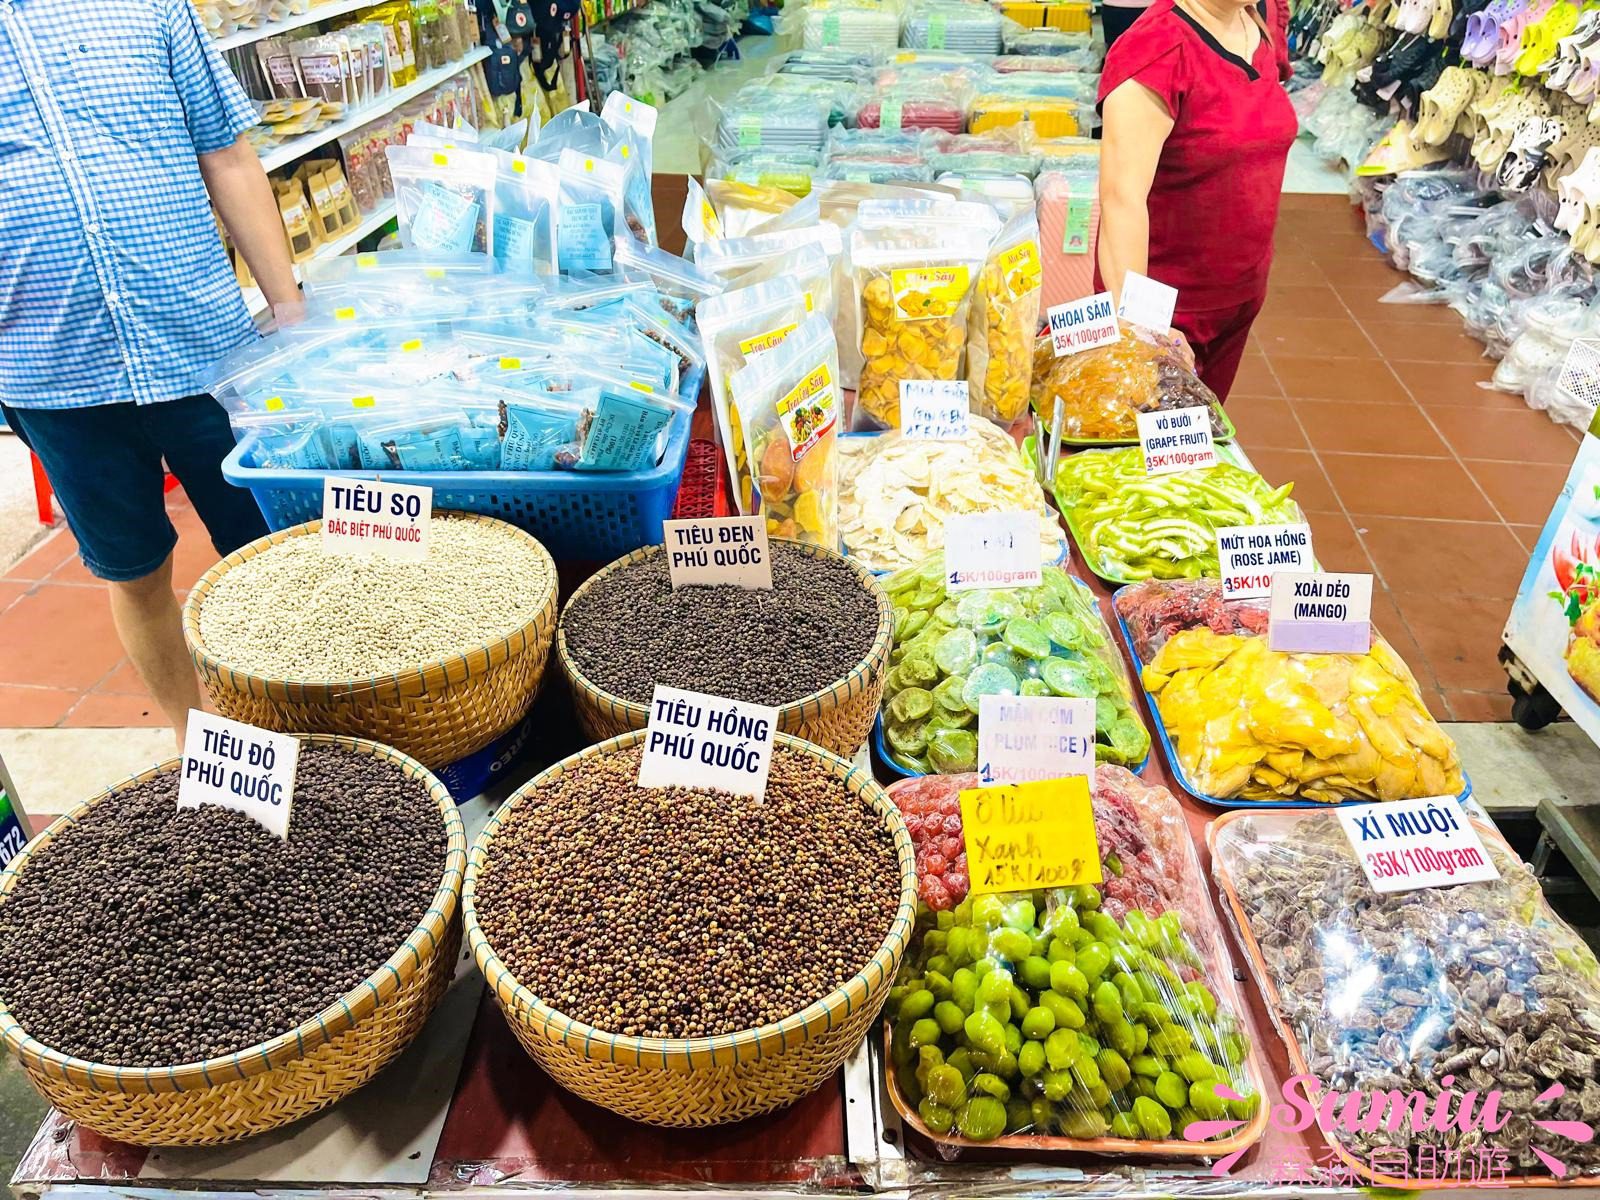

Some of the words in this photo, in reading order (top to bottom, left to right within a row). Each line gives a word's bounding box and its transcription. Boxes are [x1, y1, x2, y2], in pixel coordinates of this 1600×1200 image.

[1050, 307, 1084, 330] KHOAI
[1156, 415, 1168, 430] VỎ
[1146, 436, 1178, 452] (GRAPE
[1180, 432, 1208, 445] FRUIT)
[331, 484, 382, 513] TIÊU
[390, 493, 421, 522] SỌ
[328, 518, 348, 538] ĐẶC
[350, 520, 370, 540] BIỆT
[372, 522, 392, 540] PHÚ
[395, 524, 420, 542] QUỐC
[675, 525, 714, 545] TIÊU
[719, 526, 754, 543] ĐEN
[1221, 534, 1244, 550] MỨT
[1248, 535, 1272, 548] HOA
[672, 547, 708, 568] PHÚ
[714, 543, 762, 566] QUỐC
[1231, 554, 1264, 569] (ROSE
[1268, 550, 1301, 566] JAME)
[1294, 580, 1322, 598] XOÀI
[1326, 579, 1350, 598] DẺO
[1294, 603, 1347, 620] (MANGO)
[656, 698, 702, 728] TIÊU
[707, 706, 768, 742] HỒNG
[203, 728, 243, 760] TIÊU
[248, 740, 276, 770] ĐỎ
[650, 732, 694, 760] PHÚ
[700, 742, 760, 773] QUỐC
[186, 758, 224, 788] PHÚ
[230, 774, 282, 806] QUỐC
[1353, 810, 1384, 841] XÍ
[1386, 803, 1460, 838] MUỘI
[976, 832, 1042, 863] Xanh
[1366, 846, 1484, 879] 35K/100gram
